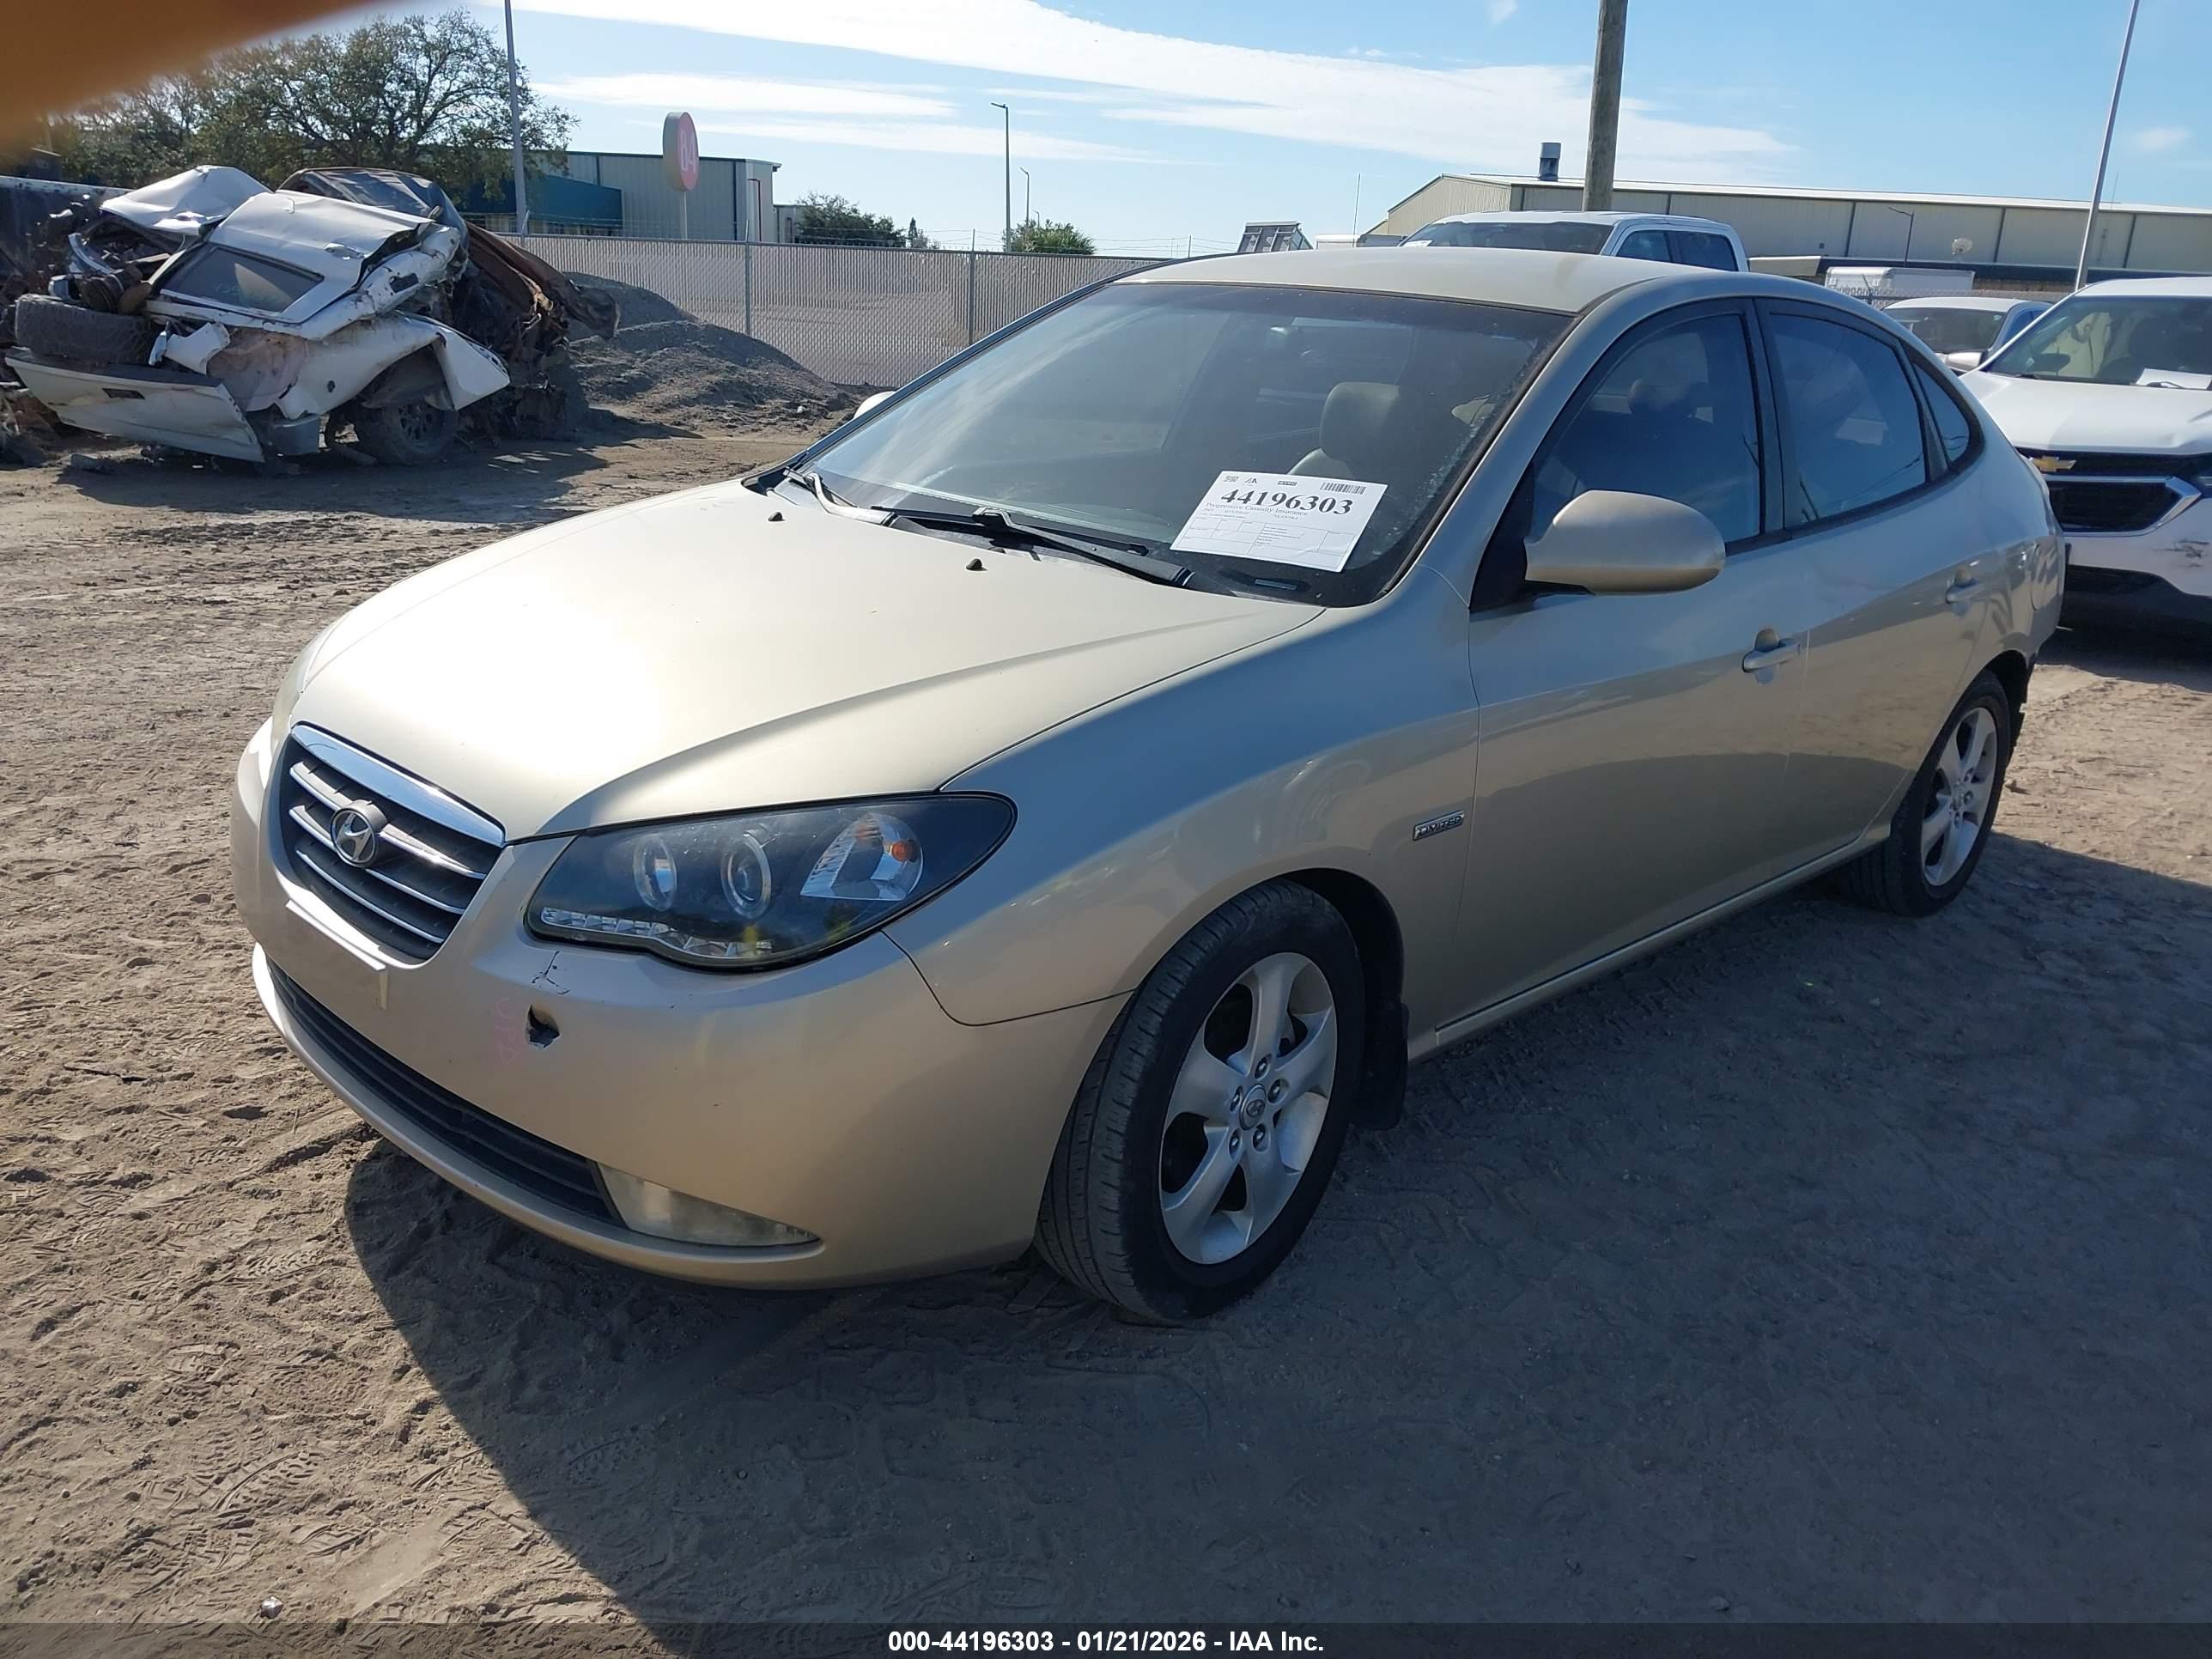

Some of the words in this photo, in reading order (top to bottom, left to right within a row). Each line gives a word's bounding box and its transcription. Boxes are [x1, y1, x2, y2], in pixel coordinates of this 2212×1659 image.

[680, 130, 697, 173] 84
[1220, 488, 1353, 515] 44196303
[1274, 507, 1309, 516] Insurance
[1416, 813, 1463, 838] LIMITED
